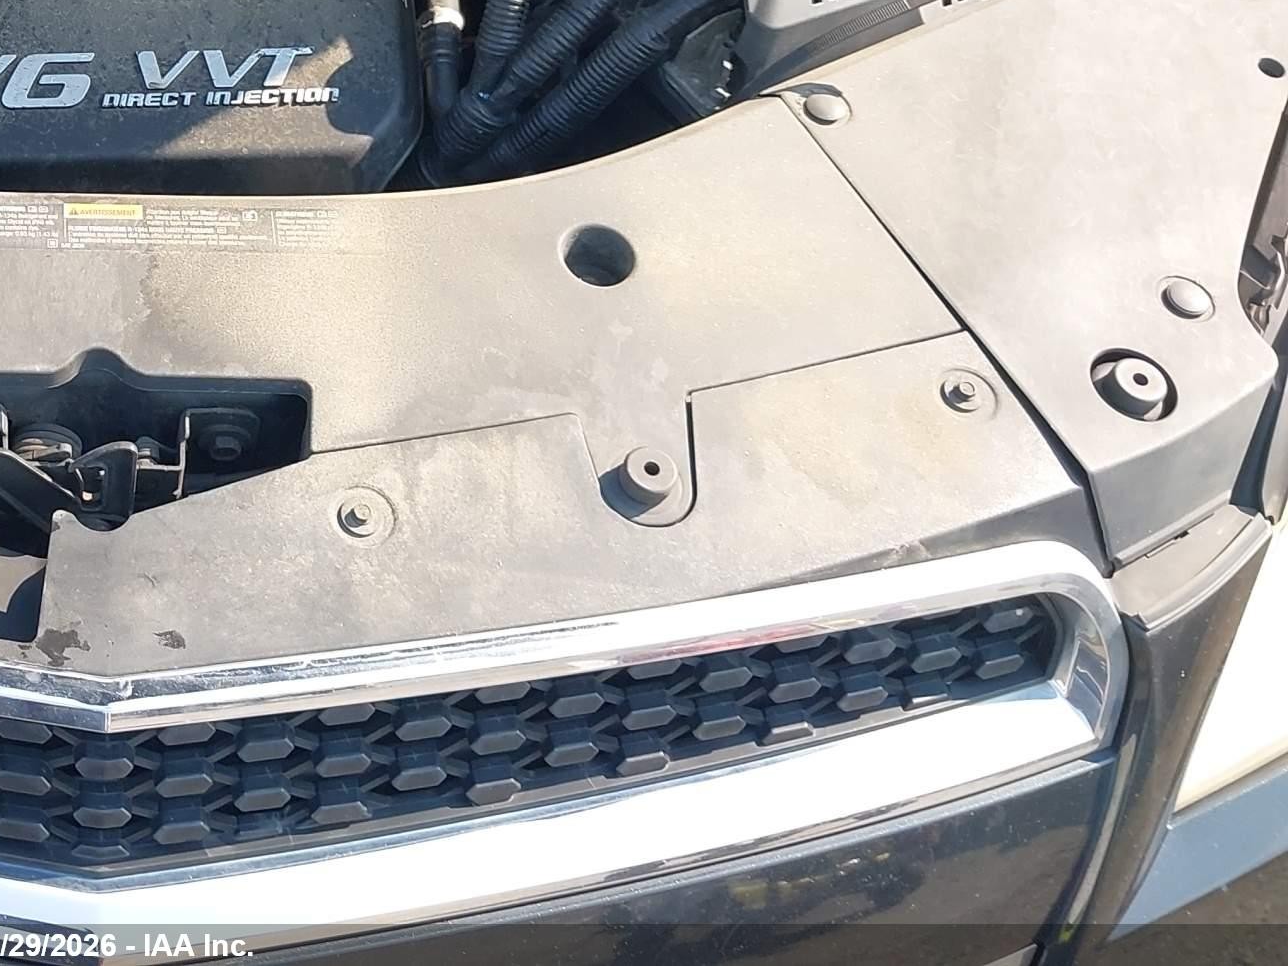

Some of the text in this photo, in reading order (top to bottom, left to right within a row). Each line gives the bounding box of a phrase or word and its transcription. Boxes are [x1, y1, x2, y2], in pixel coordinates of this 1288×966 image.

[135, 46, 315, 90] VVT
[102, 87, 341, 110] DIRECT INJECTION
